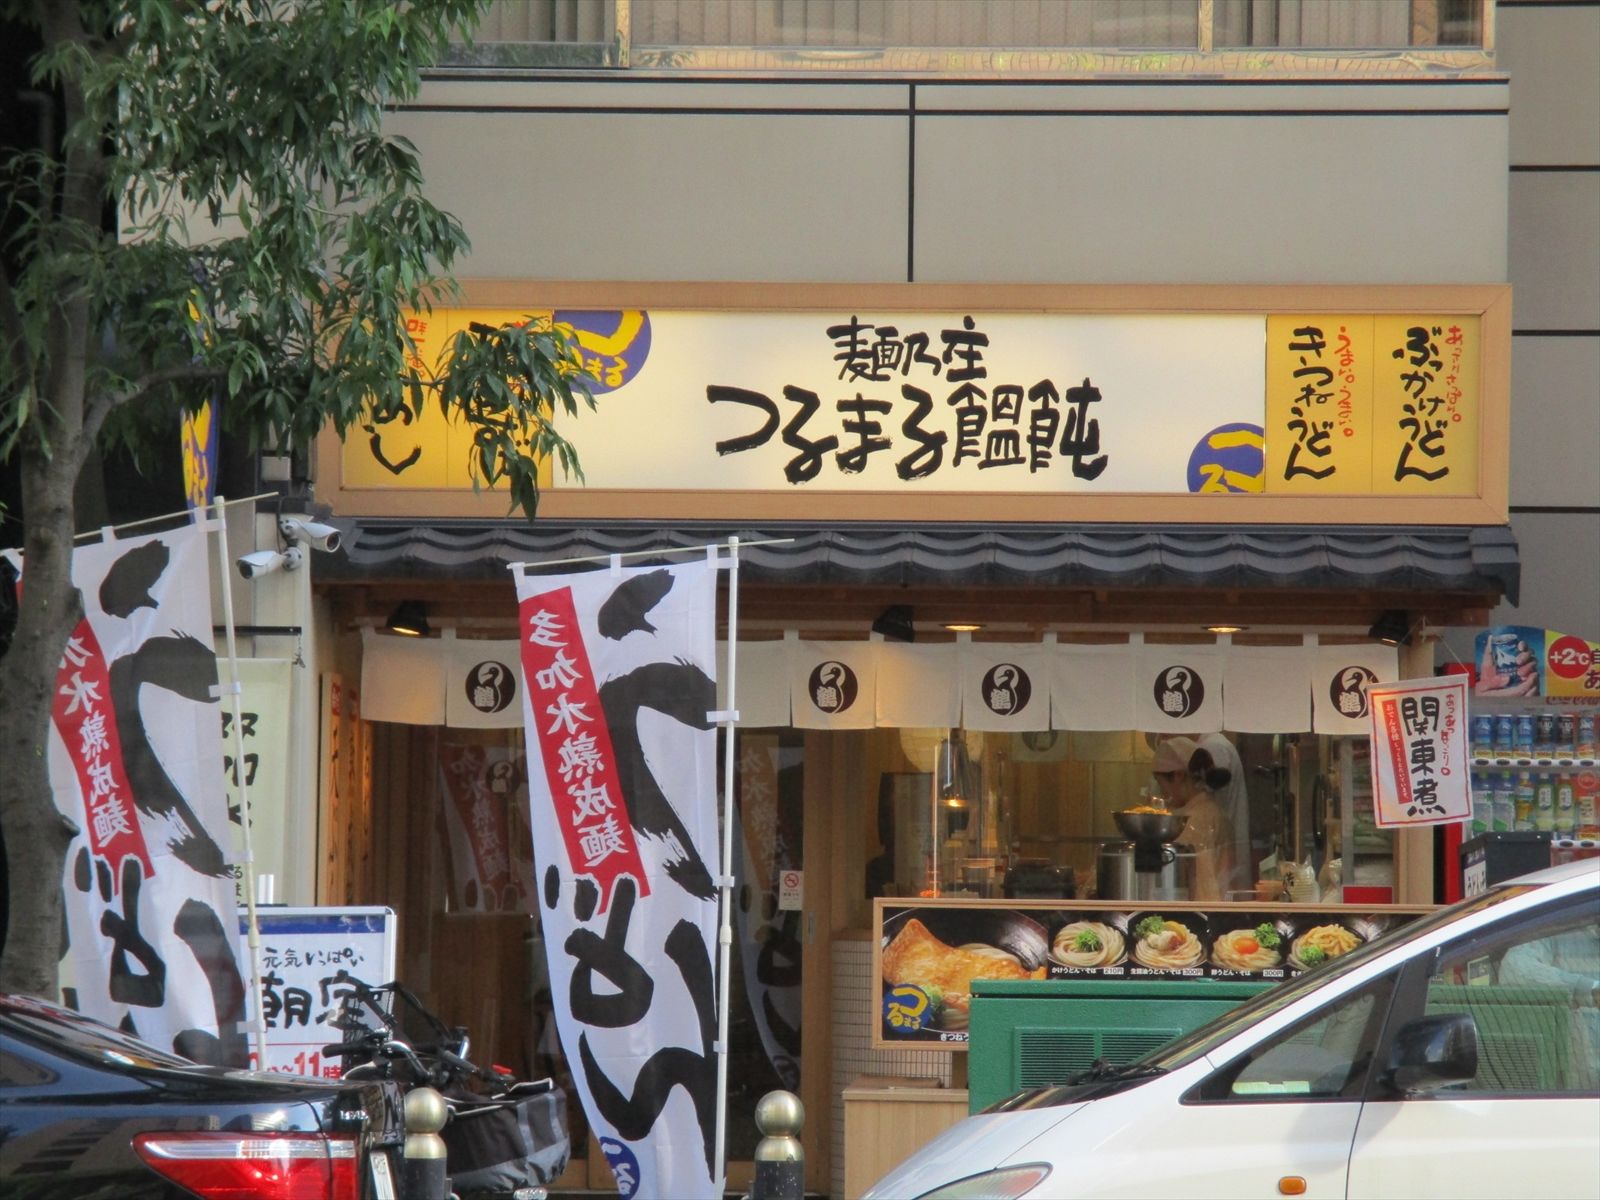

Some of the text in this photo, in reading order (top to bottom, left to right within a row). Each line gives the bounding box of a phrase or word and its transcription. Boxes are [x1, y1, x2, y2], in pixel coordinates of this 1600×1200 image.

[706, 377, 1108, 486] つるまる饂飩
[1284, 325, 1336, 481] きつねうどん
[1392, 326, 1450, 482] ぶっかけうどん
[1401, 696, 1447, 817] 関東煮
[263, 947, 365, 968] 元気いっぱい
